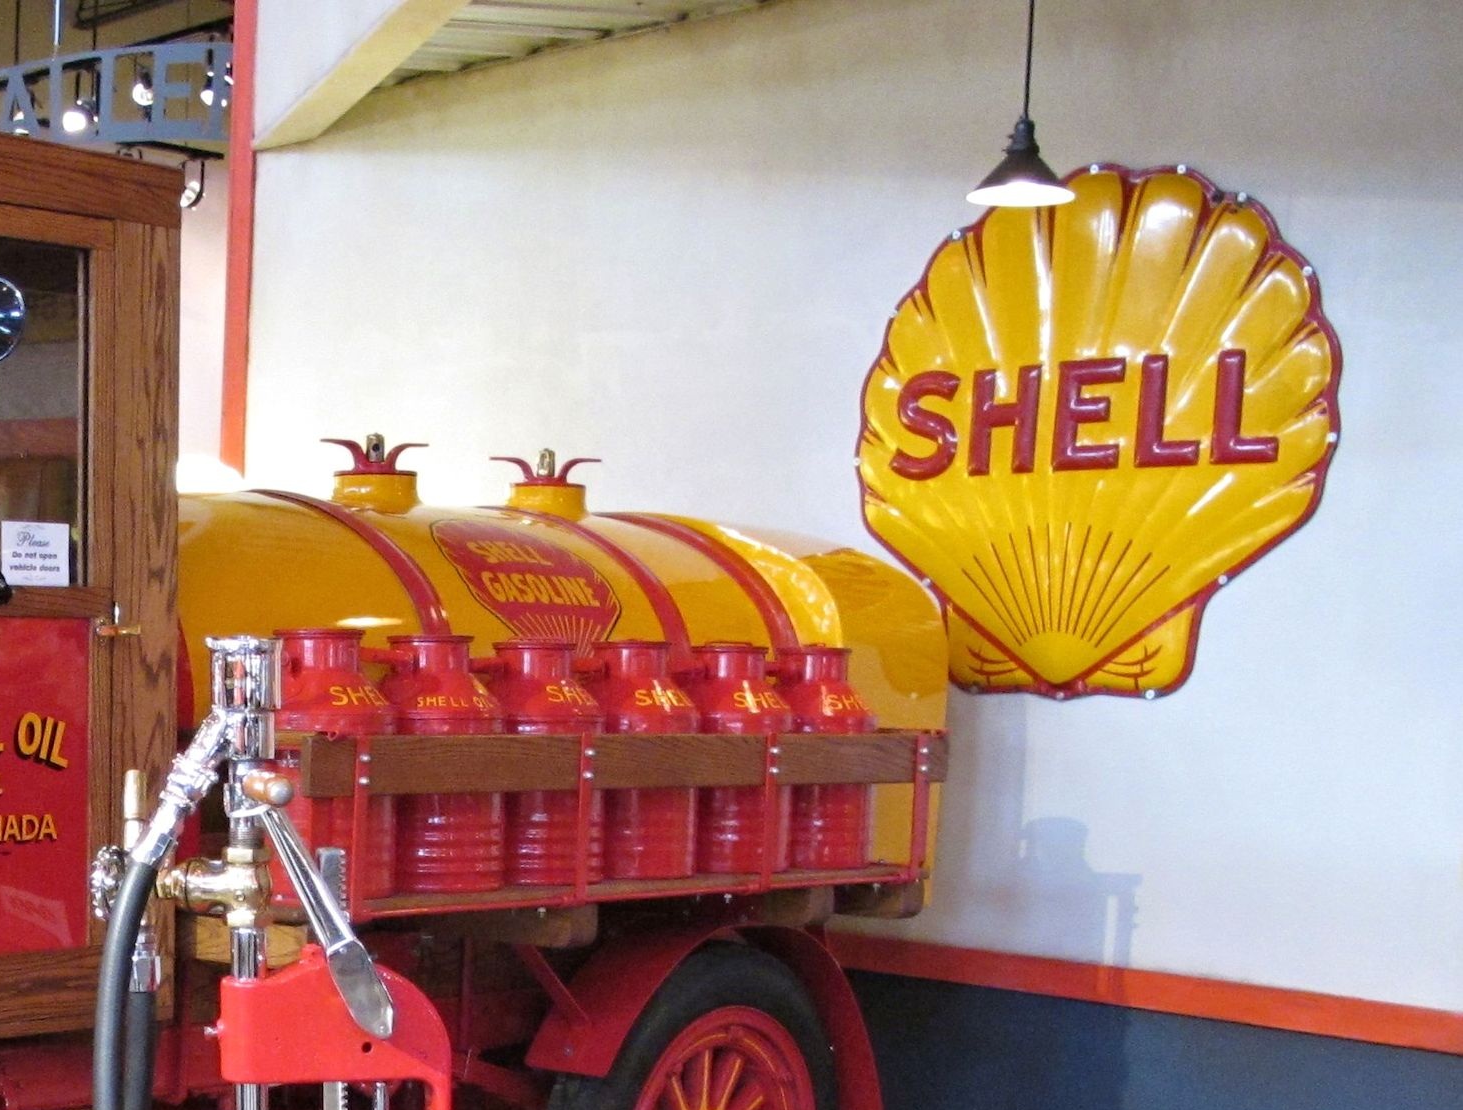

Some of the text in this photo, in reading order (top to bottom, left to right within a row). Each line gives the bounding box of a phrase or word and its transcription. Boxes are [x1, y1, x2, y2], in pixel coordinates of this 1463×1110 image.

[888, 348, 1280, 481] SHELL
[17, 531, 50, 547] Please
[466, 540, 554, 566] SHELL
[39, 564, 60, 572] doors
[481, 571, 600, 607] GASOLINE
[417, 696, 468, 707] SHELL
[17, 712, 68, 768] OIL
